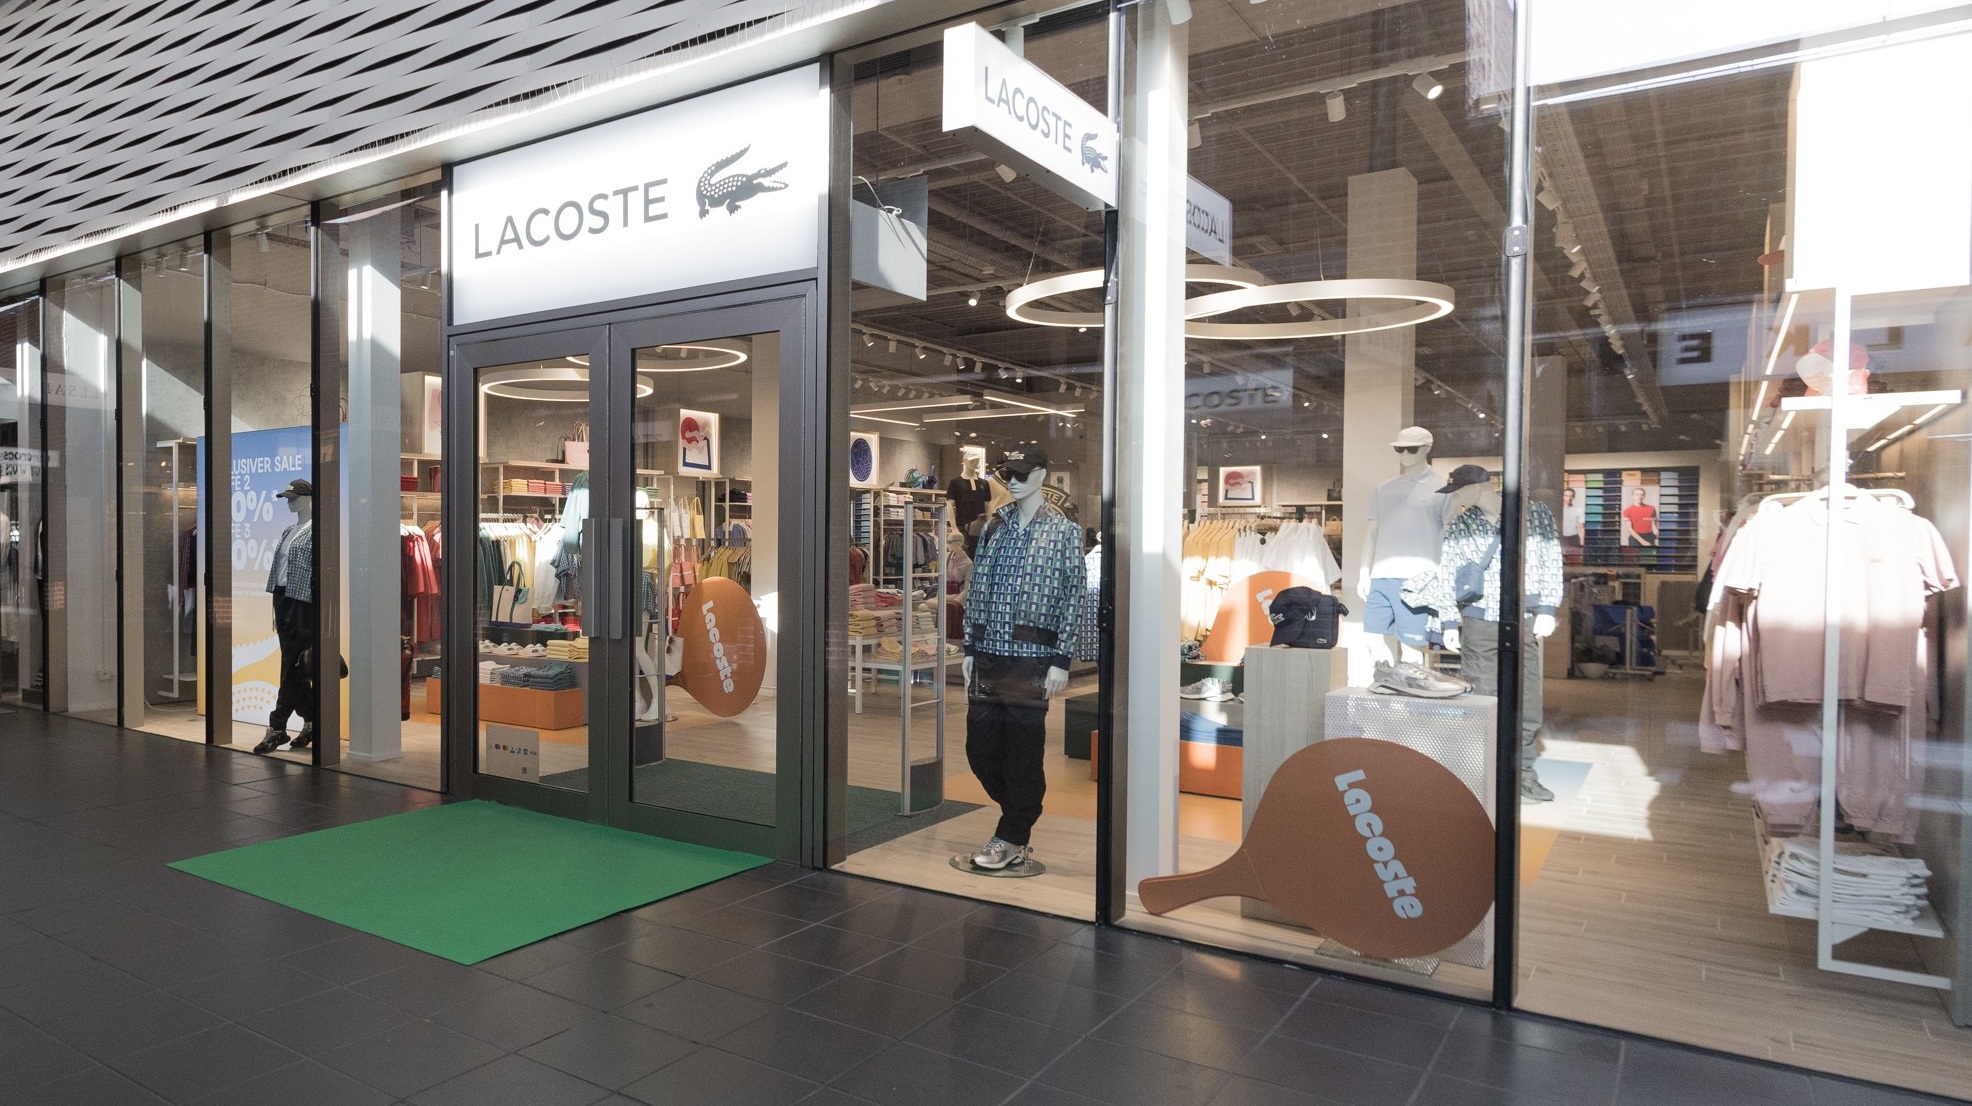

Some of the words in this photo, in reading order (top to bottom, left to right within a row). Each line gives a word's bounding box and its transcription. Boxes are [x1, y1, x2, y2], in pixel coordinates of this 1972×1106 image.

[983, 65, 1073, 154] LACOSTE
[474, 177, 669, 260] LACOSTE
[1185, 385, 1279, 410] COSTE
[231, 456, 272, 475] USIVER
[274, 454, 302, 472] SALE
[243, 474, 251, 491] 2
[244, 523, 251, 539] 3
[701, 599, 735, 694] Lacoste
[1334, 768, 1424, 920] Lacoste
